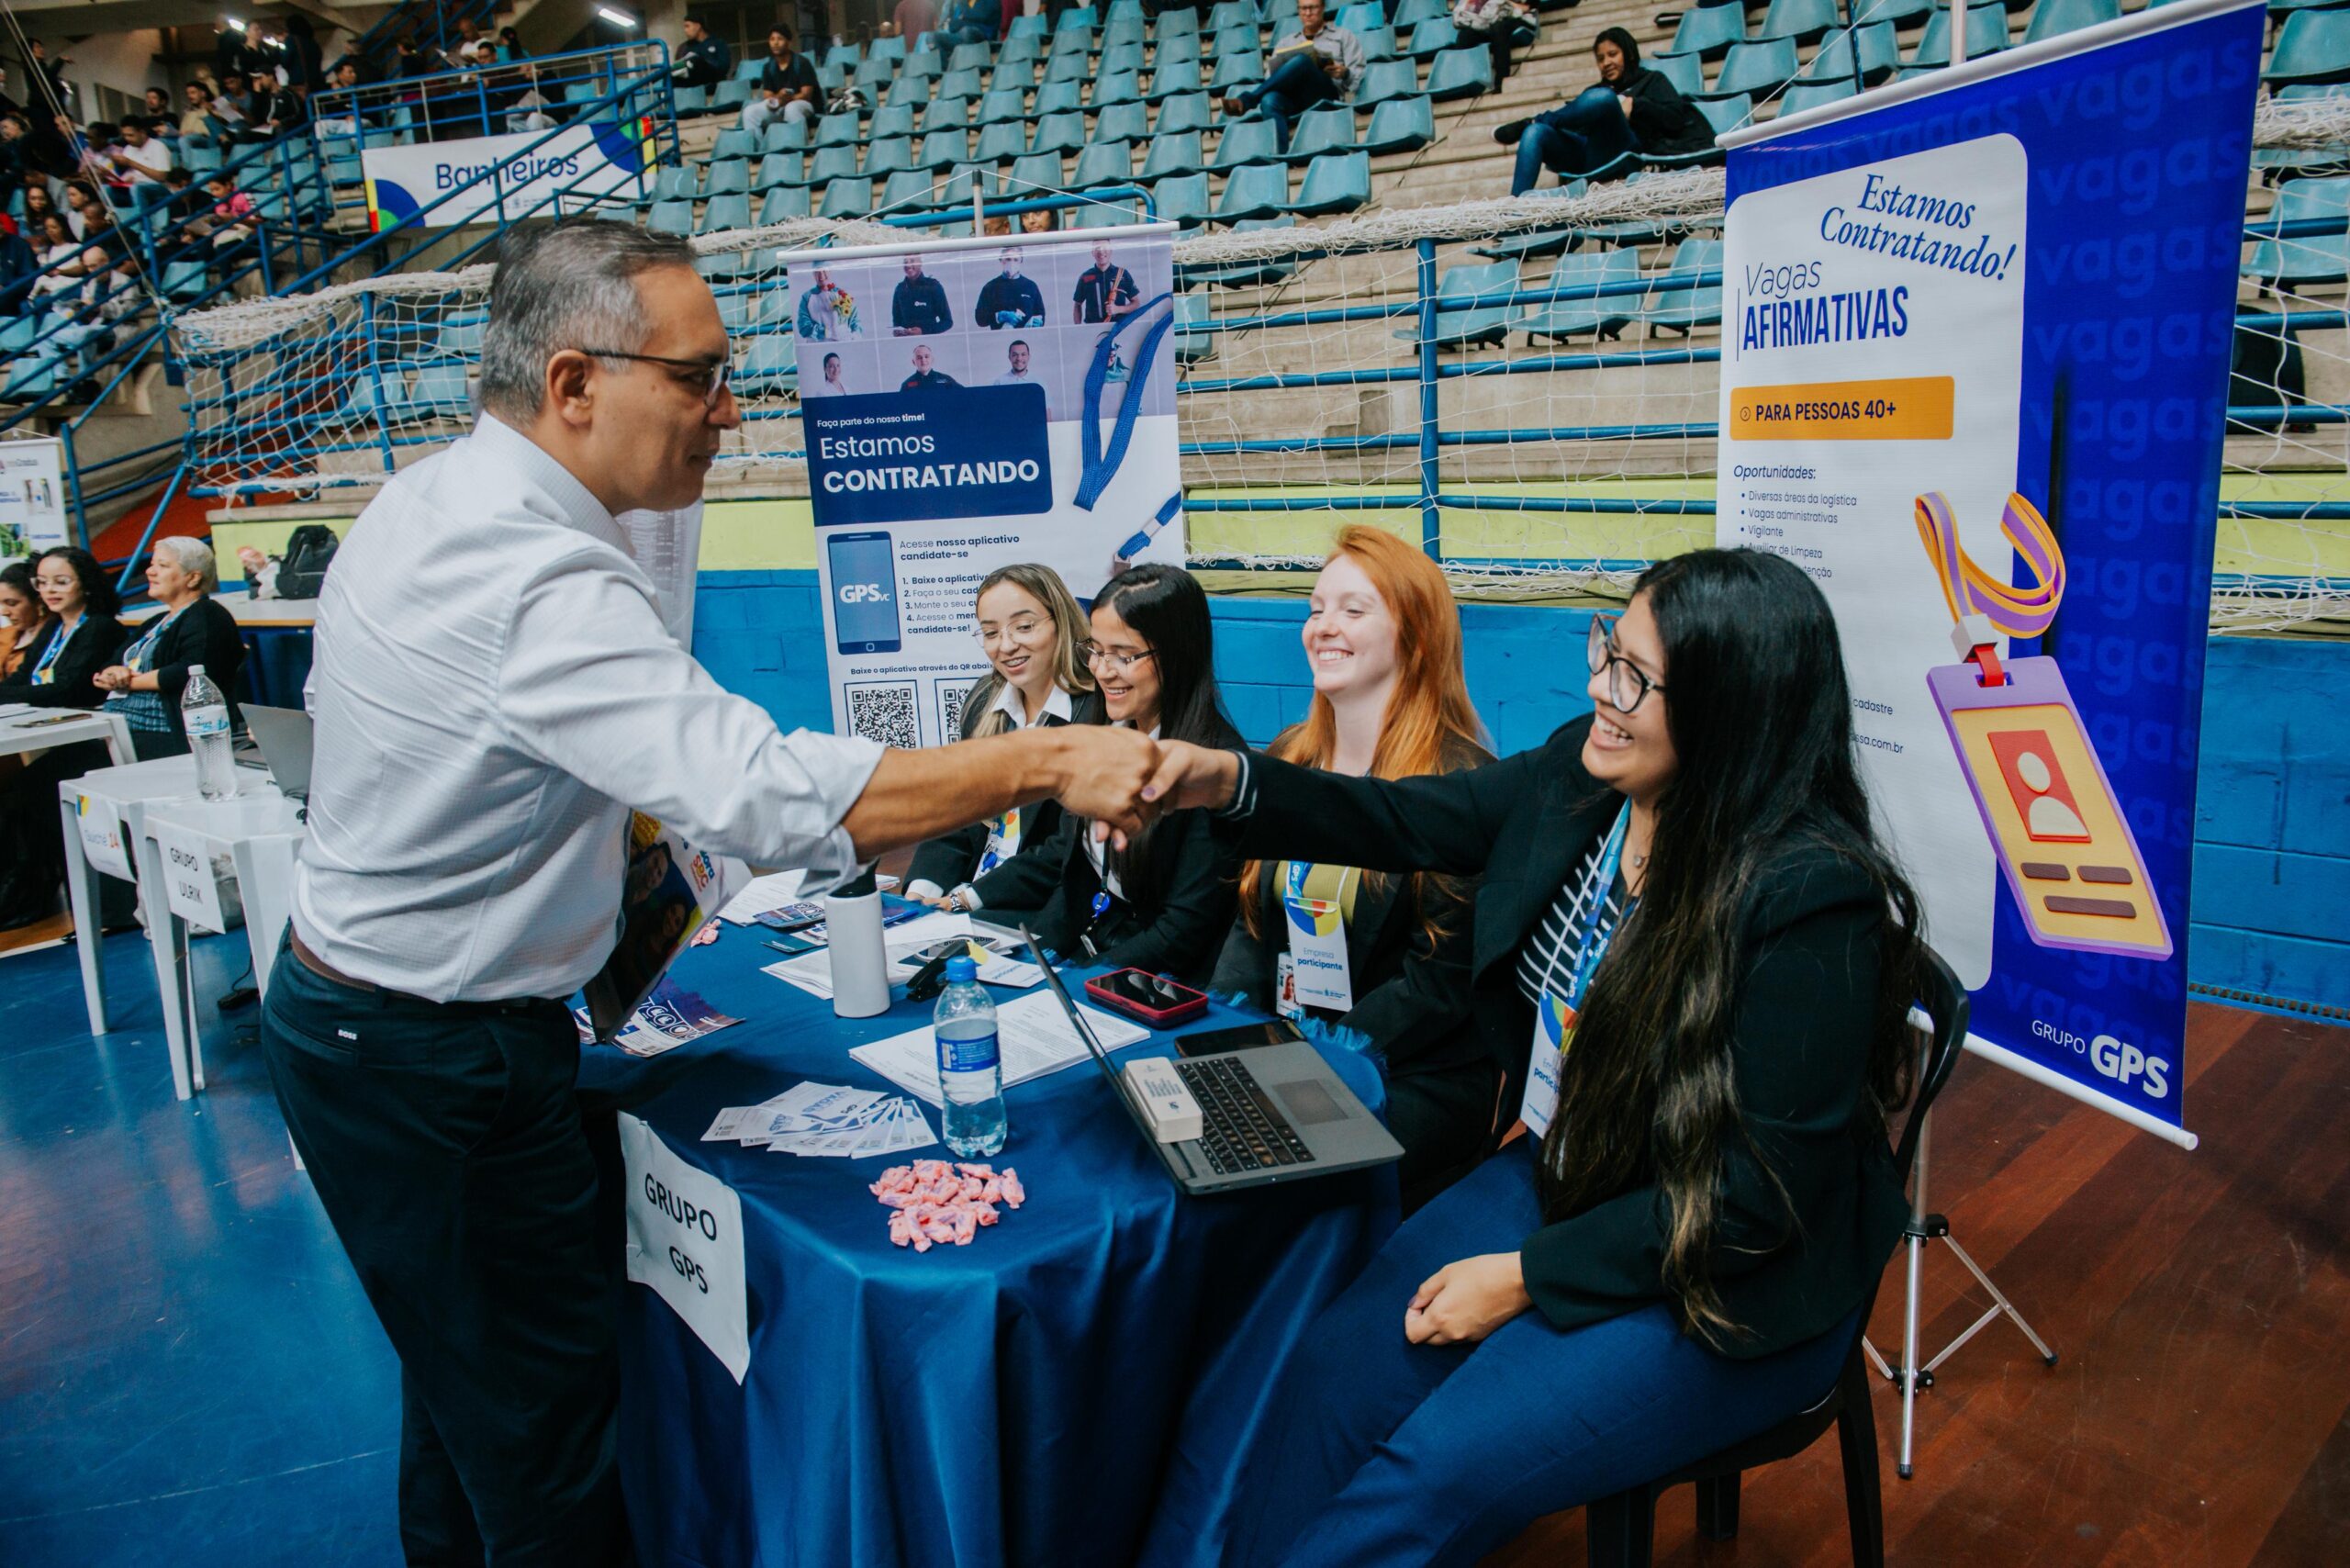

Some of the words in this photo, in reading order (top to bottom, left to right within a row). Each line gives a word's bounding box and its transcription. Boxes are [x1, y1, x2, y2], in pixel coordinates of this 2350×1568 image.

[2038, 38, 2249, 131] vagas
[435, 151, 578, 190] Banheiros
[2036, 130, 2244, 216] vagas
[1857, 174, 1975, 229] Estamos
[1820, 207, 2017, 281] Contratando!
[2034, 219, 2238, 298] vagas
[1746, 261, 1822, 299] Vagas
[1742, 286, 1908, 351] AFIRMATIVAS
[2031, 308, 2231, 382] vagas
[817, 420, 838, 429] Faça
[840, 418, 862, 428] parte
[864, 416, 875, 425] do
[876, 415, 901, 424] nosso
[901, 413, 925, 422] time!
[1756, 405, 1791, 421] PARA
[1796, 401, 1861, 420] PESSOAS
[1864, 399, 1897, 420] 40+
[820, 435, 935, 460] Estamos
[823, 459, 1040, 493] CONTRATANDO
[1733, 465, 1817, 481] Oportunidades:
[1749, 490, 1783, 502] Diversas
[1784, 491, 1806, 503] áreas
[1807, 494, 1818, 504] da
[1820, 493, 1857, 508] logística
[1748, 508, 1774, 521] Vagas
[1776, 510, 1838, 523] administrativas
[900, 541, 934, 549] Acesse
[936, 539, 966, 547] nosso
[968, 534, 1020, 547] aplicativo
[1748, 525, 1784, 538] Vigilante
[901, 551, 968, 561] candidate-se
[1779, 544, 1789, 555] de
[1791, 545, 1822, 560] Limpeza
[912, 576, 936, 585] Baixe
[903, 589, 911, 598] 2.
[912, 589, 934, 599] Faça
[944, 588, 959, 596] seu
[905, 601, 912, 610] 3.
[914, 600, 941, 610] Monte
[916, 612, 946, 622] Acesse
[908, 624, 970, 634] candidate-se!
[879, 665, 917, 675] aplicativo
[918, 664, 947, 672] através
[959, 663, 970, 671] QR
[972, 662, 993, 670] abaix
[1852, 697, 1894, 716] cadastre
[170, 847, 198, 872] GRUPO
[1297, 958, 1344, 971] participante
[2031, 1020, 2086, 1054] GRUPO
[2090, 1035, 2170, 1099] GPS
[1534, 1068, 1560, 1094] particip
[644, 1172, 717, 1241] GRUPO
[668, 1246, 709, 1294] GPS
